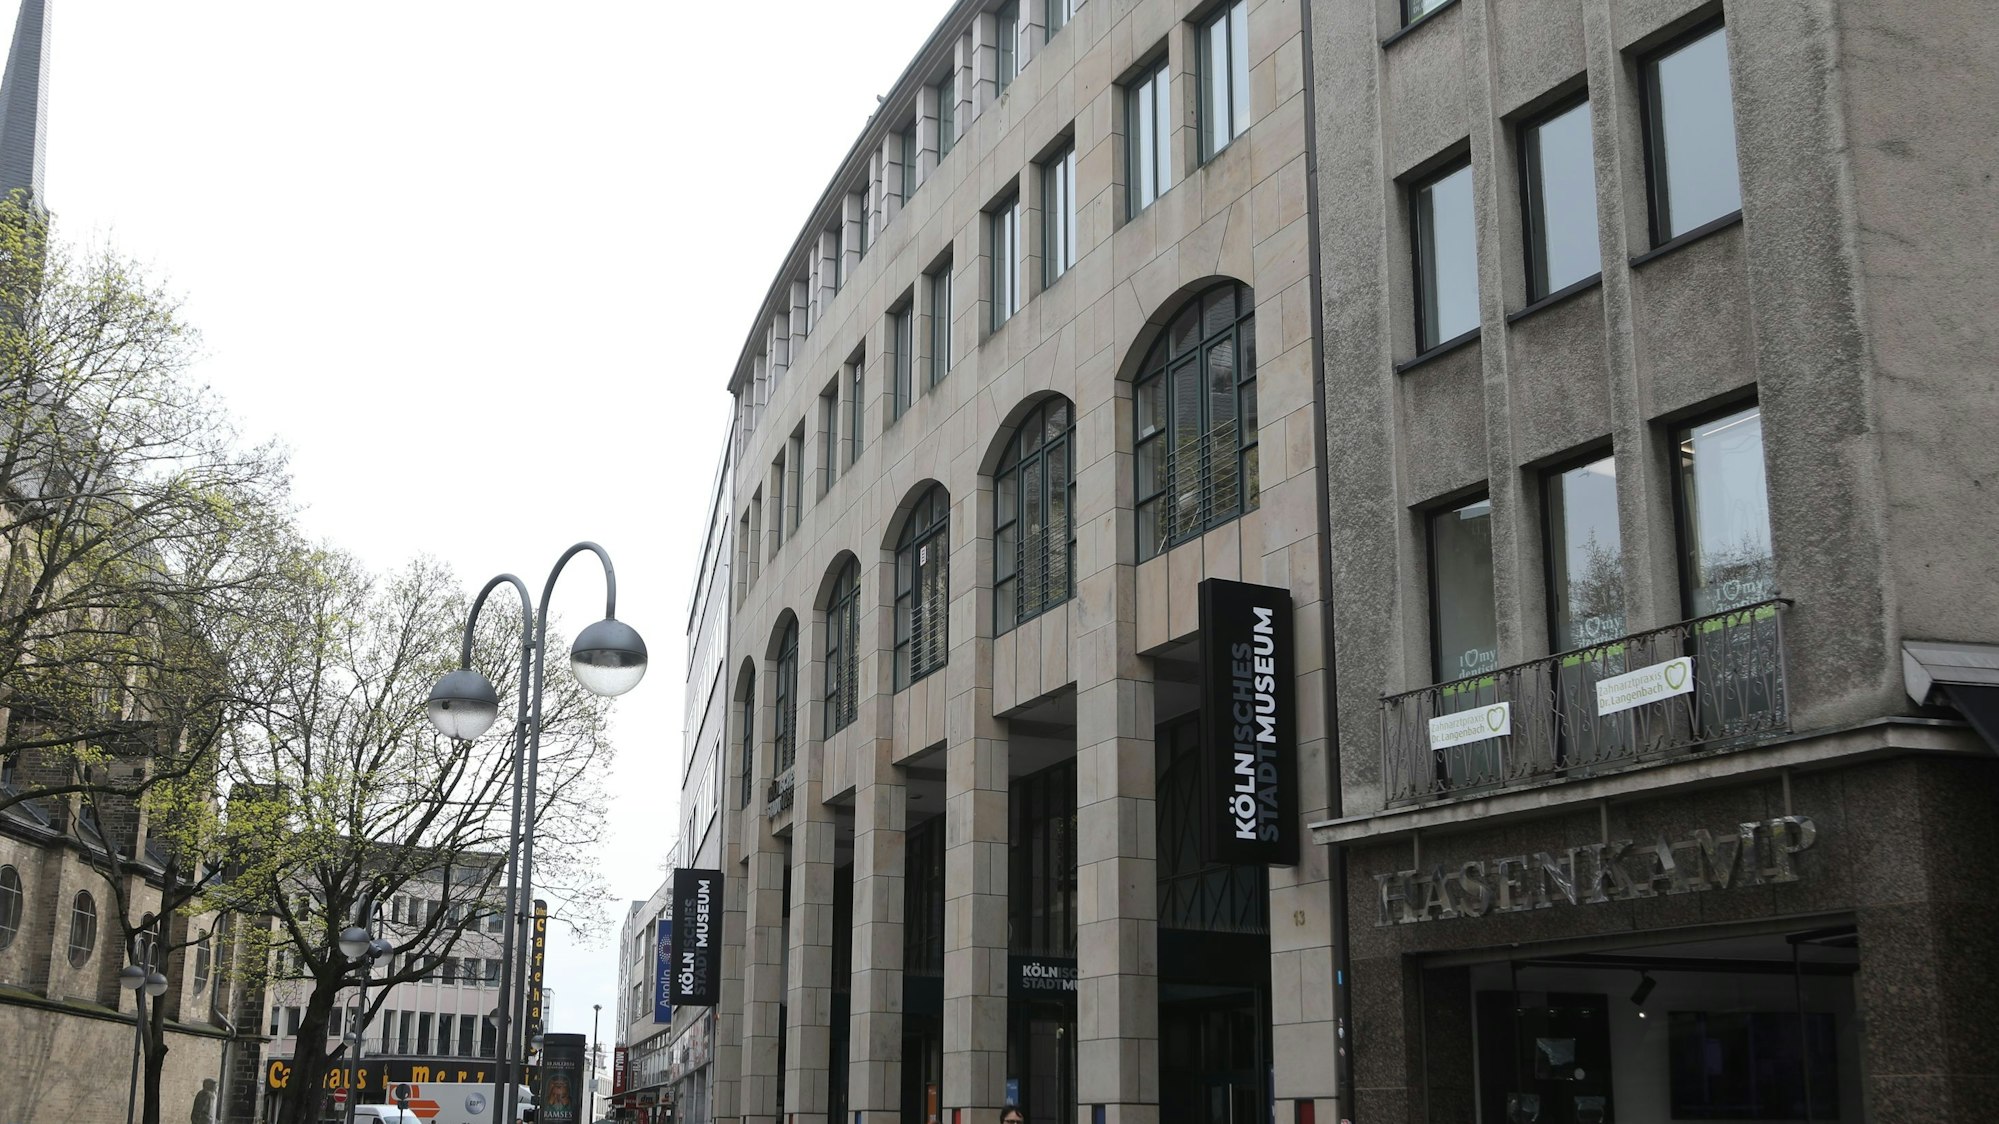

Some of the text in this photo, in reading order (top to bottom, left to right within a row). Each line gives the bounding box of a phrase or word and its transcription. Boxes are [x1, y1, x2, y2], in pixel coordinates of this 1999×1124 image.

[1479, 649, 1496, 662] my
[1599, 671, 1663, 697] Zahnarztpraxis
[1228, 642, 1257, 840] KÖLNISCHES
[1253, 606, 1280, 843] STADTMUSEUM
[1431, 714, 1485, 733] Zahnarztpraxis
[1373, 815, 1817, 927] HASENKAMP
[678, 898, 696, 995] KÖLNISCHES
[694, 879, 710, 996] STADTMUSEUM
[543, 1111, 573, 1119] RAMSES
